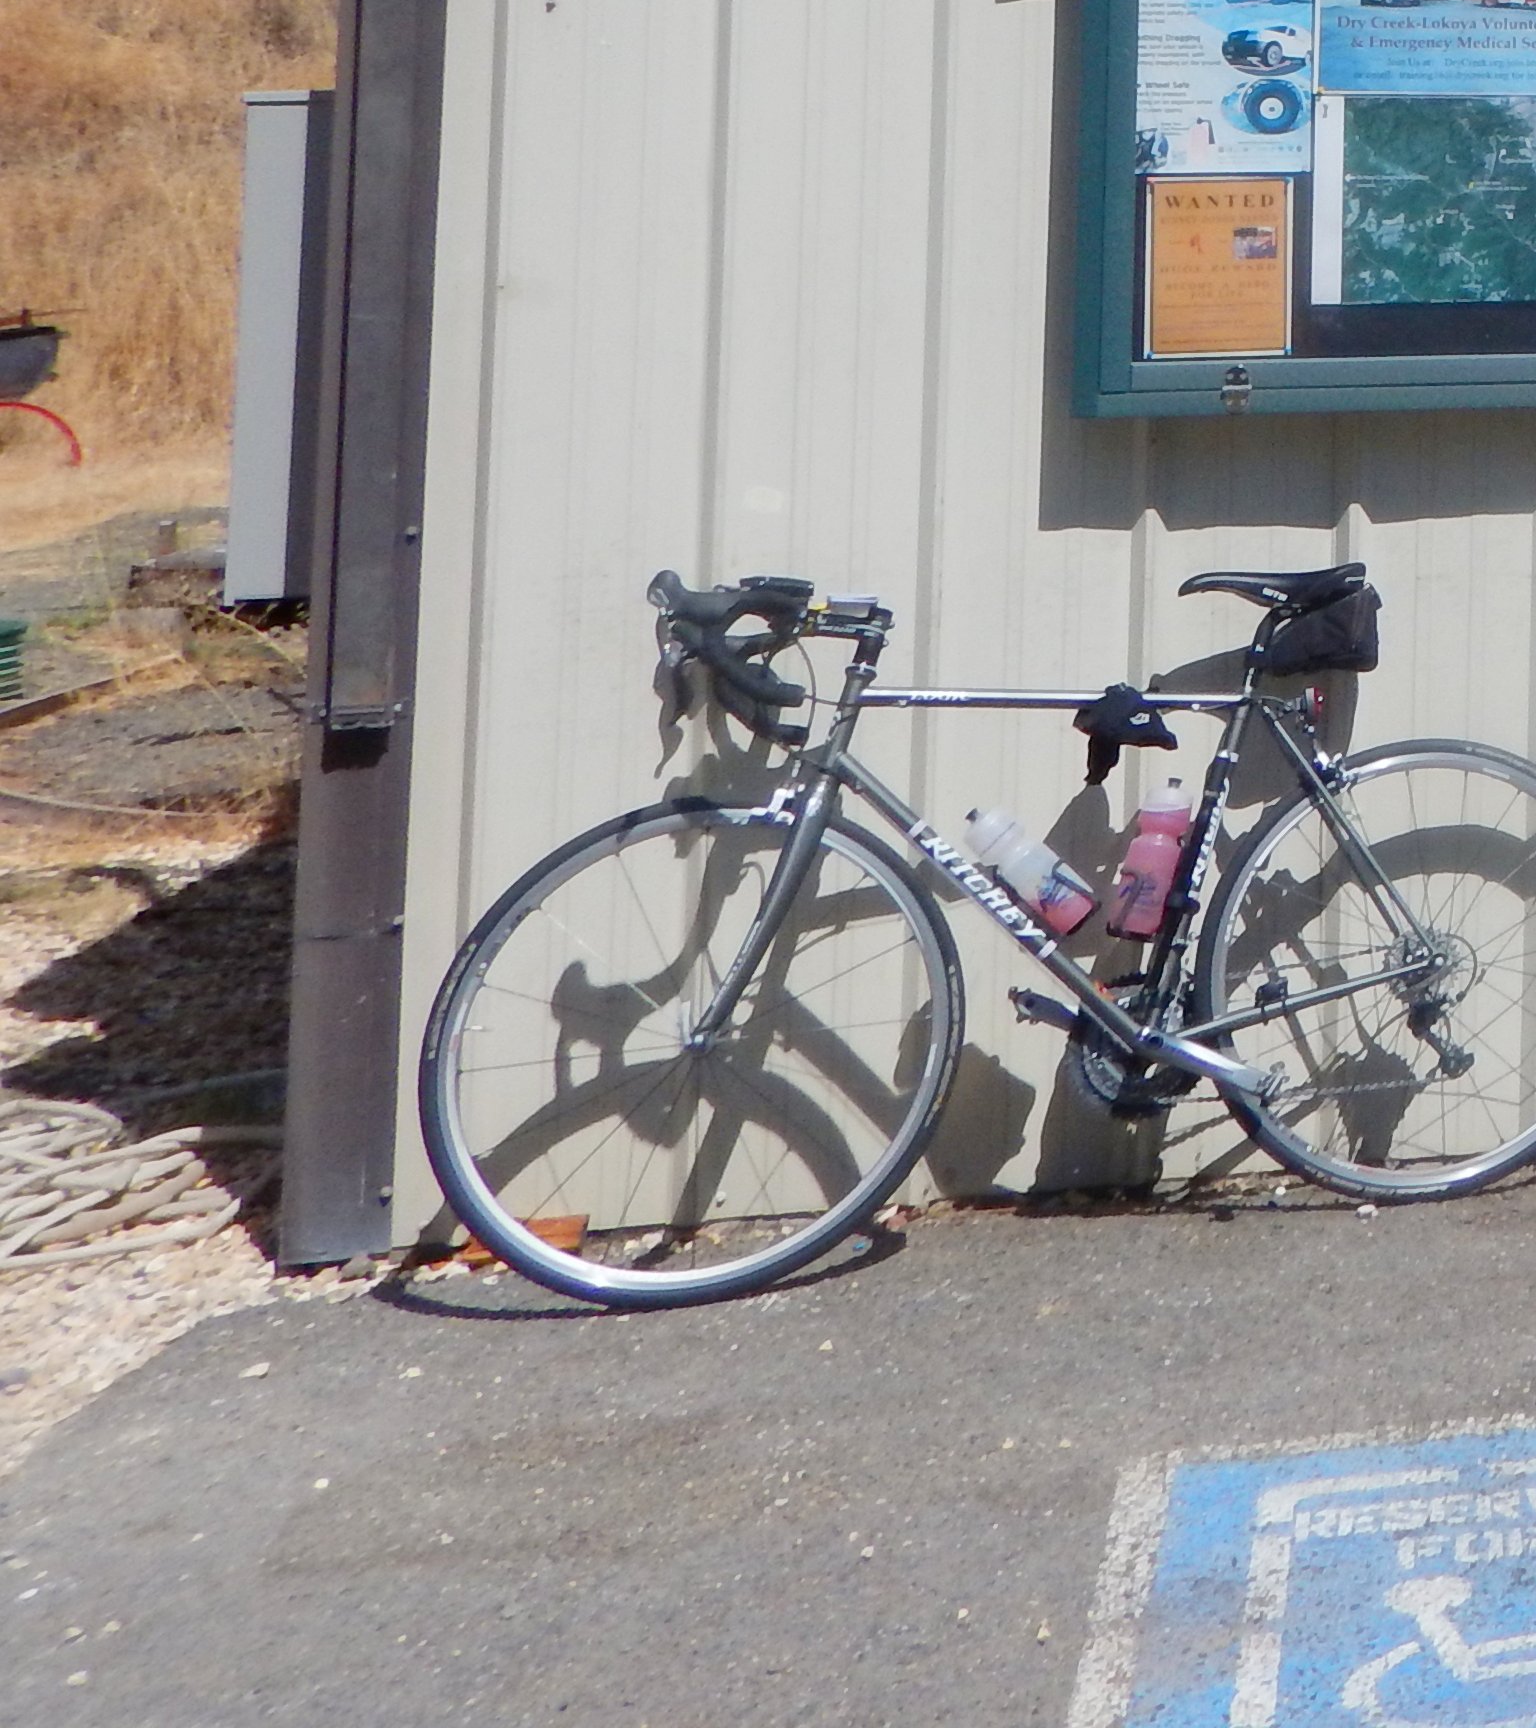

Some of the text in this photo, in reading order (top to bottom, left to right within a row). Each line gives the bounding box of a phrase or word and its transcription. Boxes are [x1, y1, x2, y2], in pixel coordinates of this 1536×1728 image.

[1337, 15, 1365, 30] Dry
[1370, 15, 1477, 31] Creek-Lokoya
[1350, 36, 1363, 49] &
[1369, 36, 1451, 52] Emergency
[1457, 35, 1517, 49] Medical
[1164, 194, 1275, 210] WANTED
[918, 836, 1048, 939] RITCHEY
